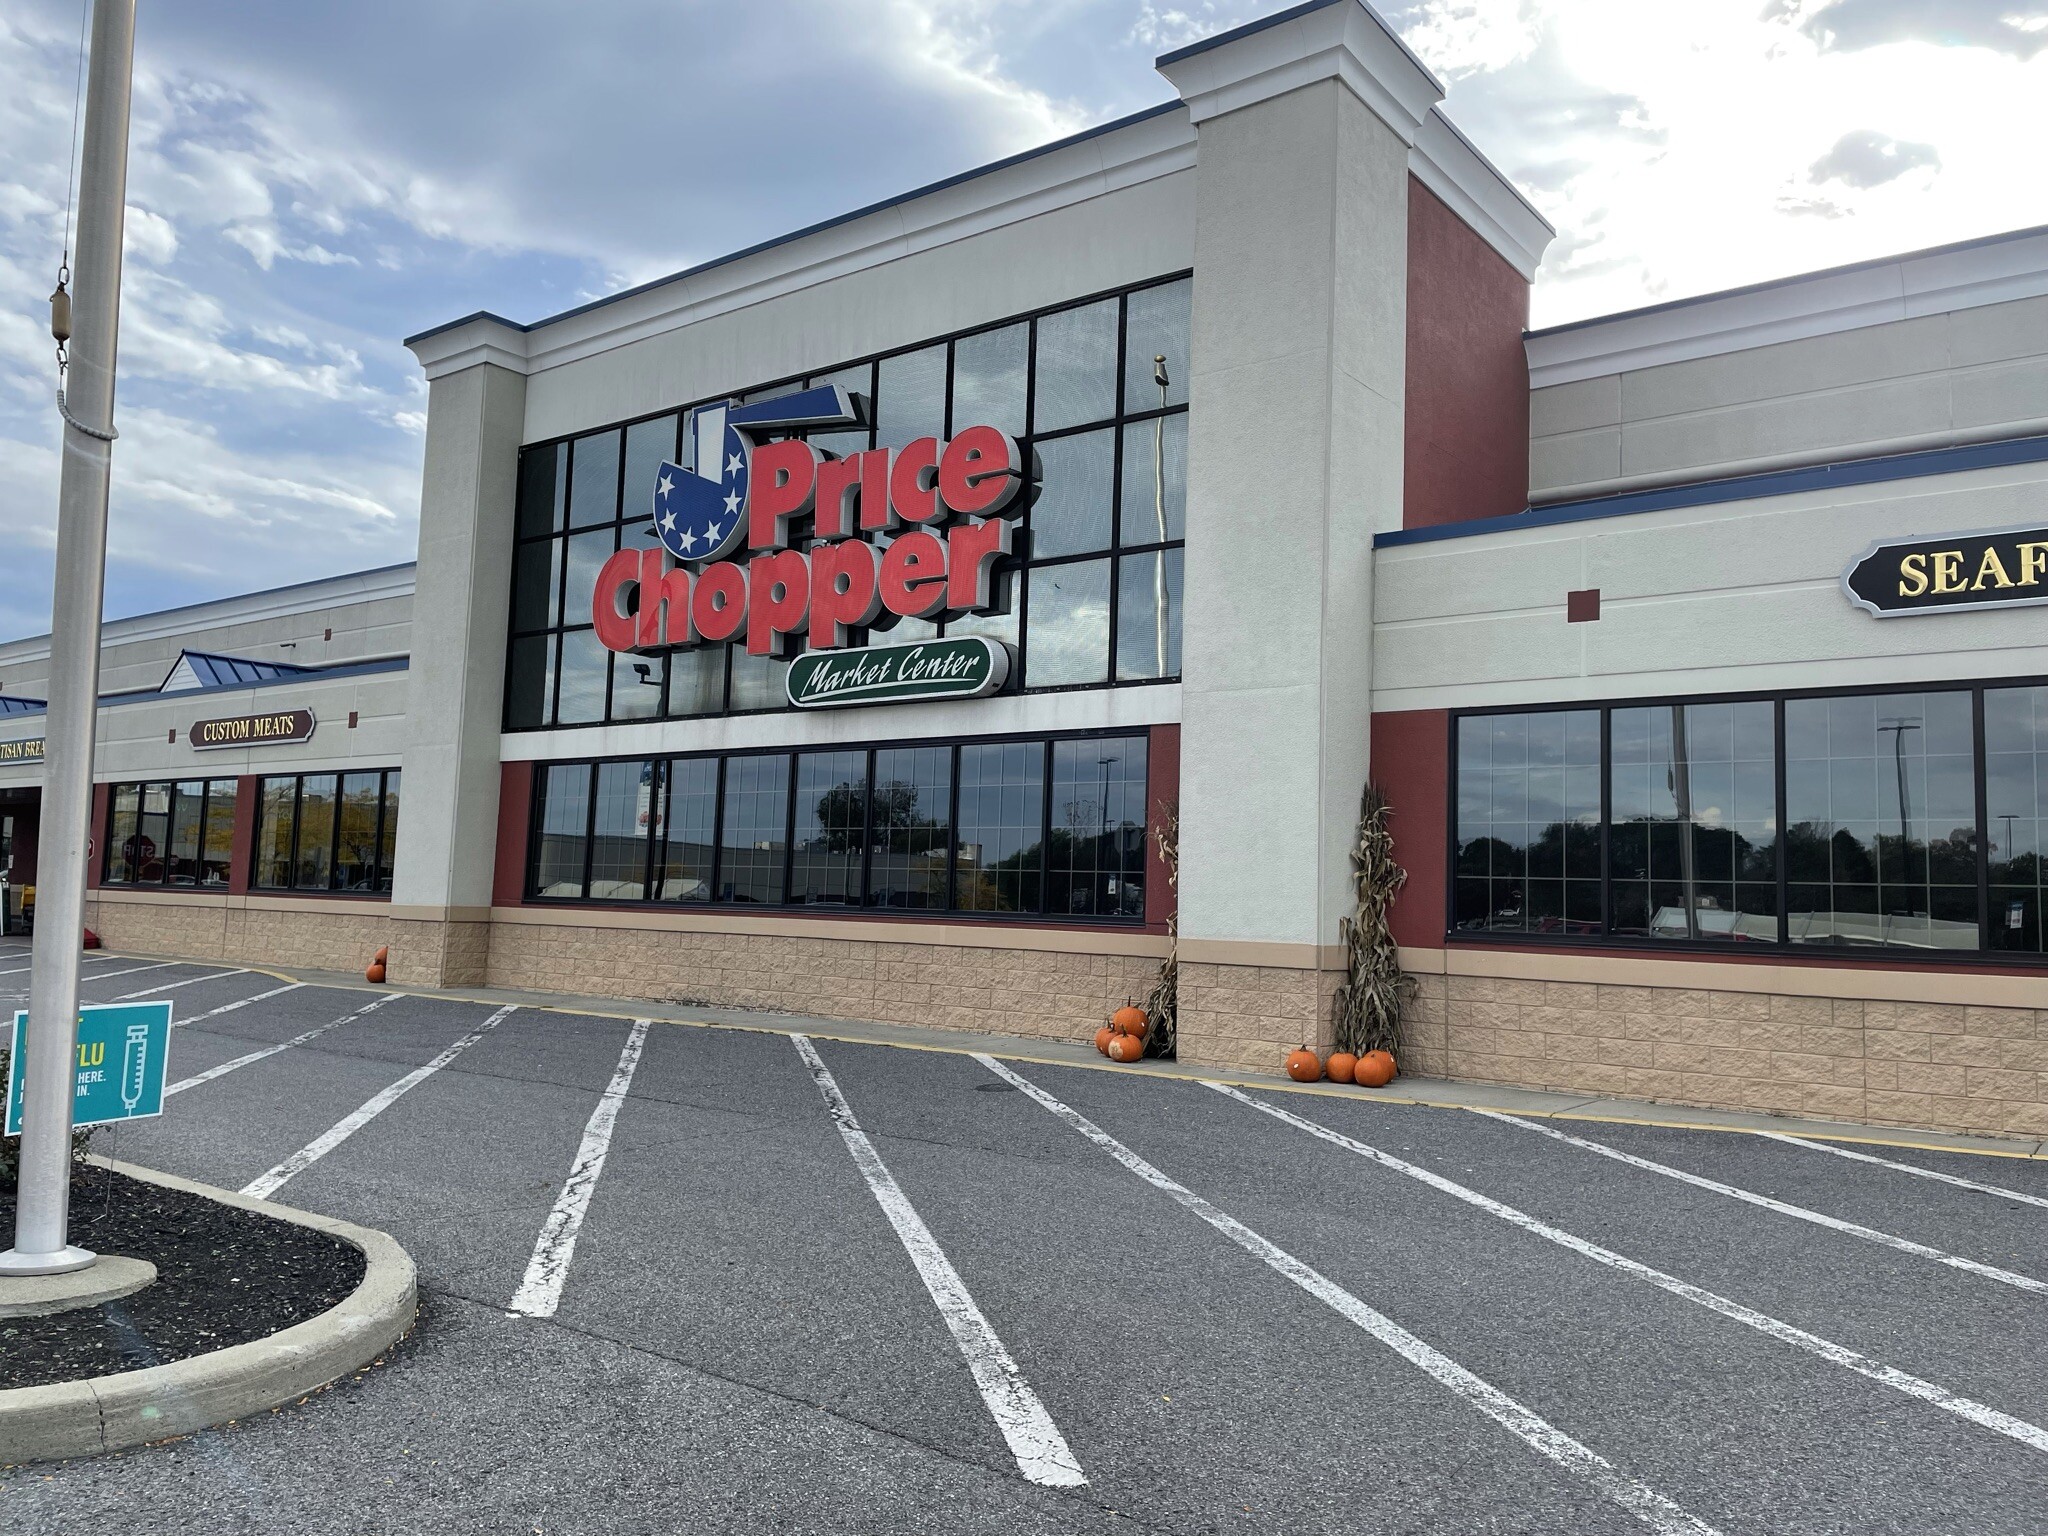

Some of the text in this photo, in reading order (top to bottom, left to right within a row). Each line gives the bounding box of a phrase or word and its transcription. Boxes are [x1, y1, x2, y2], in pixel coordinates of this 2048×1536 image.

[749, 425, 1016, 551] Price
[592, 517, 1011, 656] Chopper
[1898, 541, 2048, 597] SEAF
[801, 646, 980, 697] Market Center
[203, 715, 294, 742] CUSTOM MEATS
[76, 1084, 90, 1097] IN.
[77, 1070, 107, 1084] HERE.
